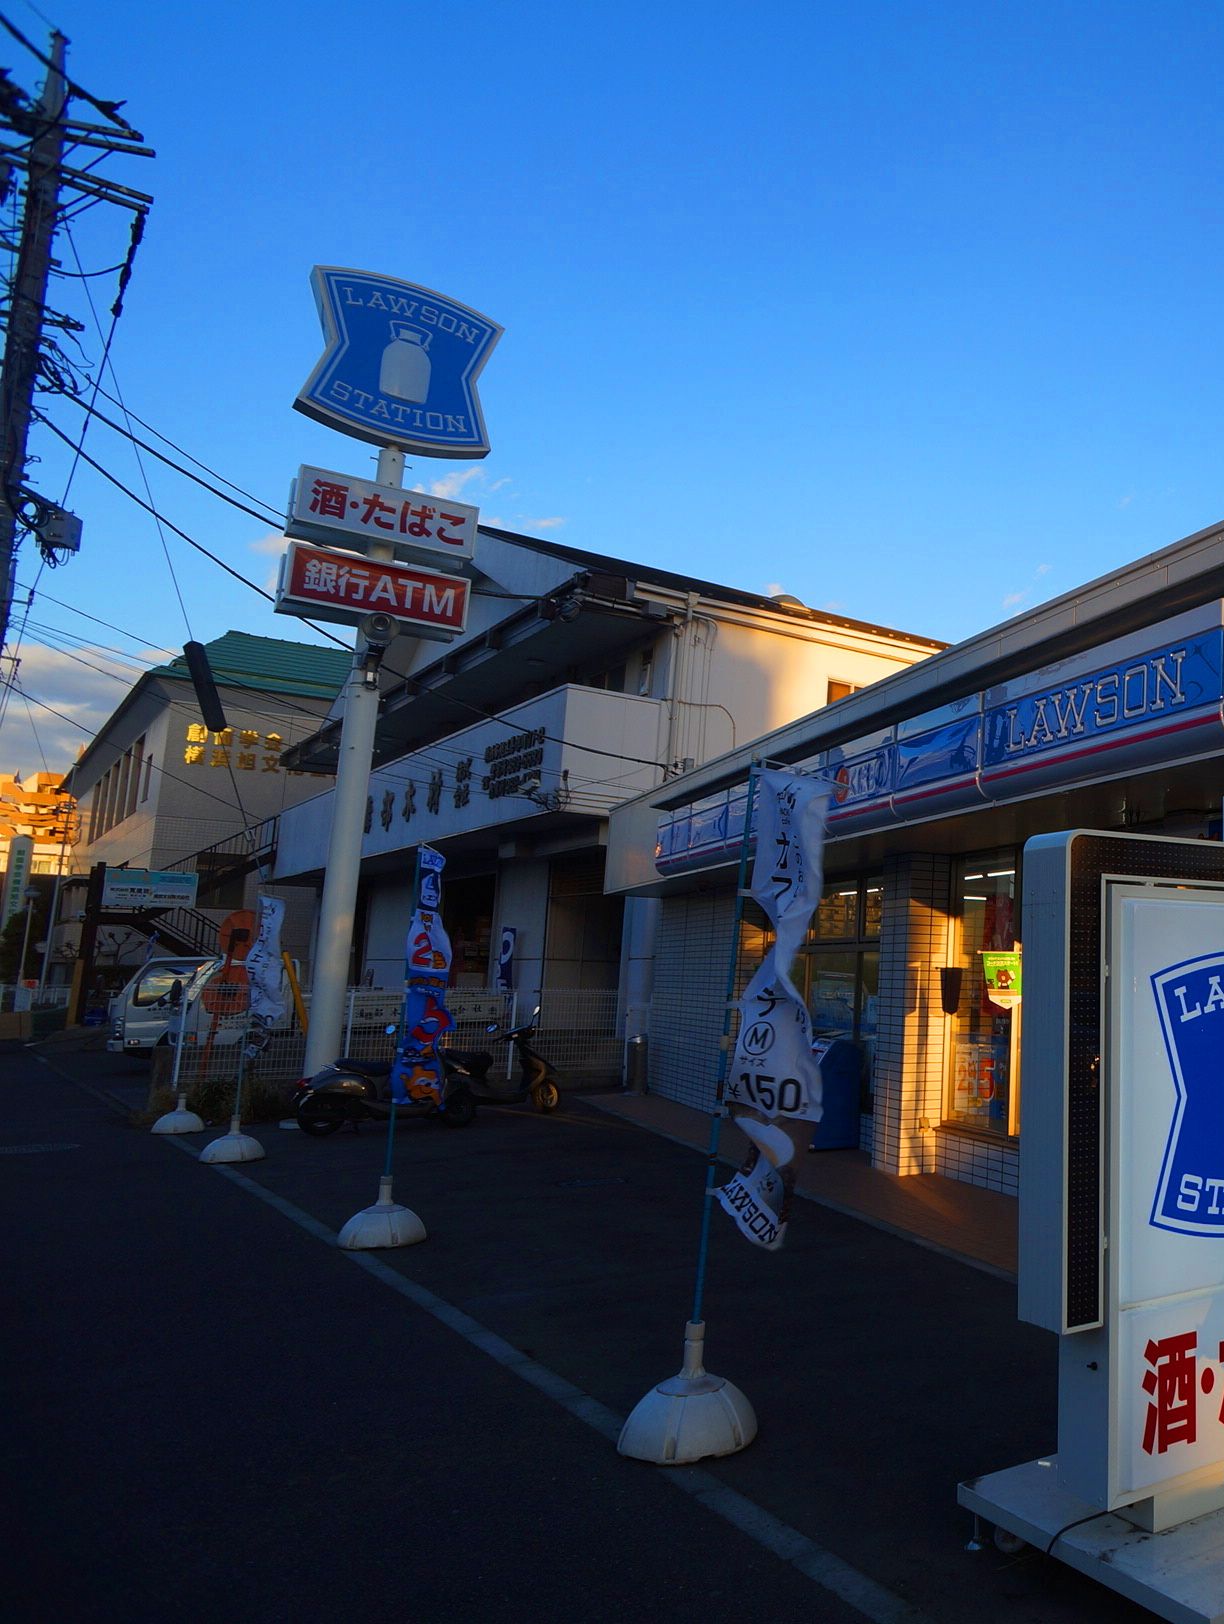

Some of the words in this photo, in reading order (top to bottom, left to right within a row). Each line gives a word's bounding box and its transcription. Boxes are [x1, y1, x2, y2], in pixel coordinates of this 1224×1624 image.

[343, 286, 480, 345] LAWSON
[330, 380, 468, 434] STATION
[308, 478, 466, 546] 酒・たばこ
[303, 558, 456, 618] 銀行ATM
[1005, 650, 1186, 753] LAWSON
[738, 1055, 768, 1068] サイズ
[727, 1072, 802, 1112] ¥150
